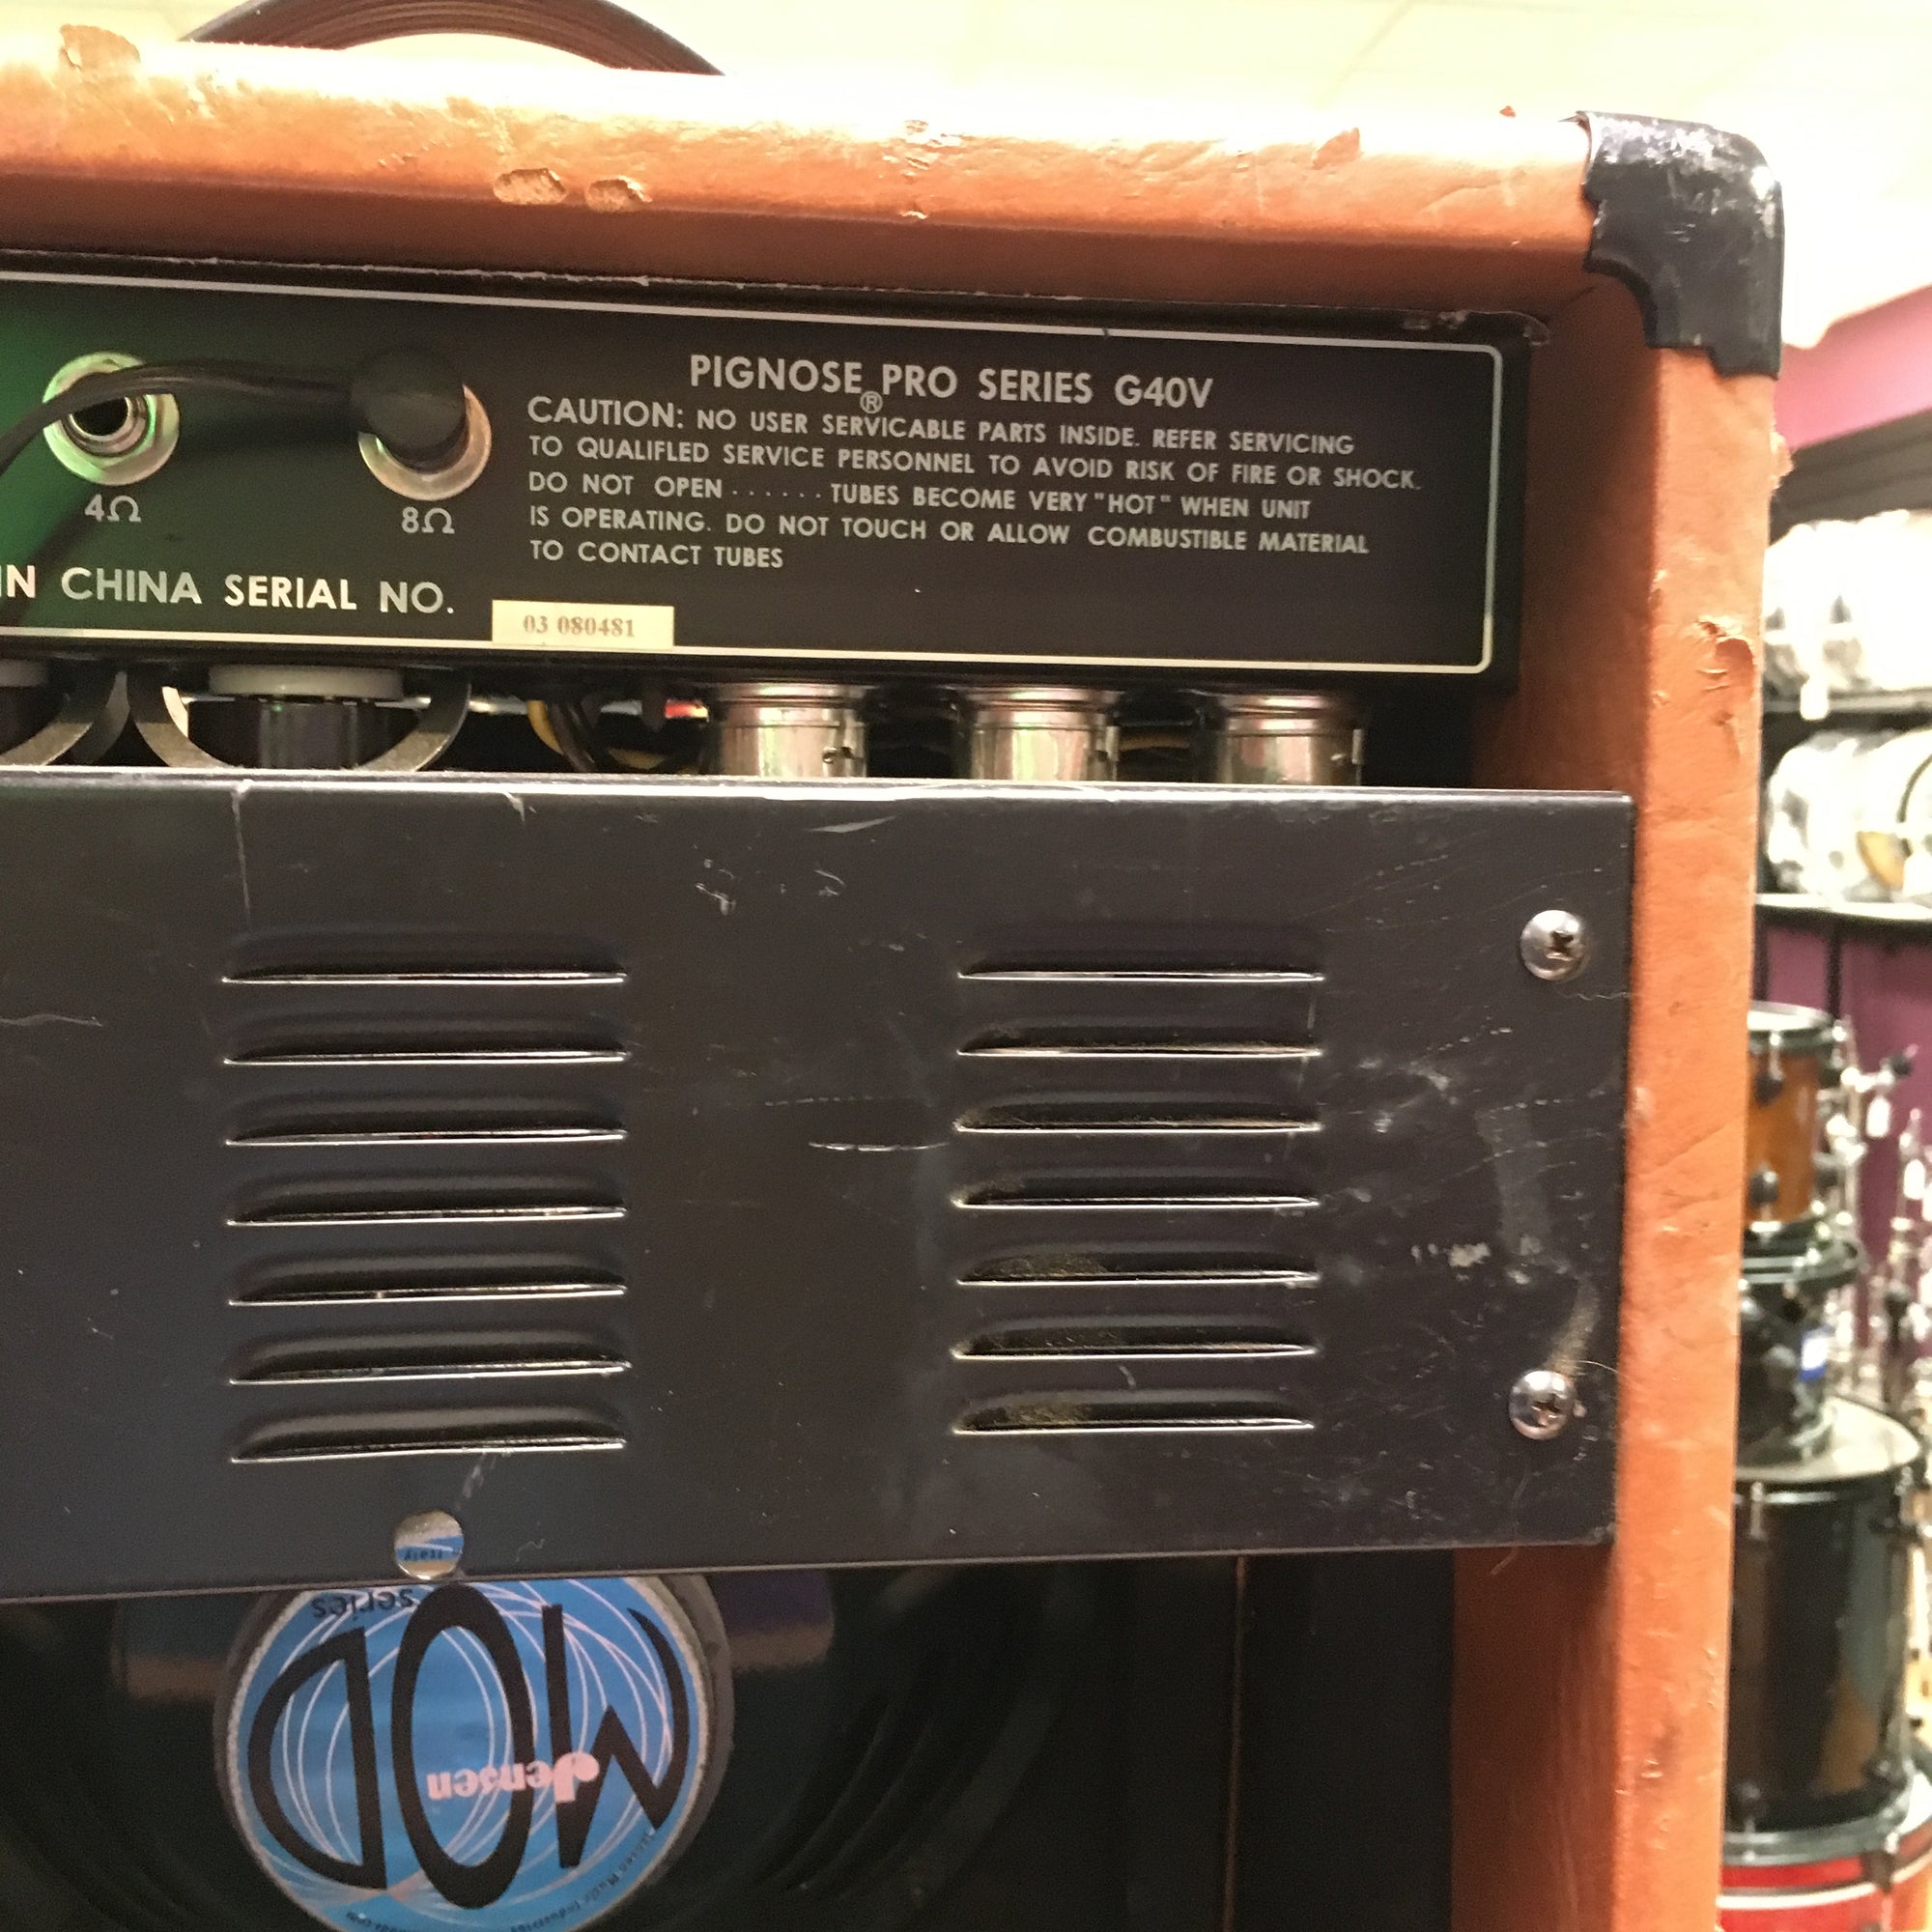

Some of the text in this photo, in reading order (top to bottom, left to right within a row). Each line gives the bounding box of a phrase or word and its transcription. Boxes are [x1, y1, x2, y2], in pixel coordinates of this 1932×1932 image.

[690, 355, 1213, 408] PIGNOSE PRO SERIES G40V
[528, 396, 1354, 455] CAUTION: NO USER SERVICABLE PARTS INSIDE. REFER SERVICING
[529, 435, 562, 458] TO
[723, 444, 825, 468] SERVICE
[838, 448, 975, 473] PERSONNEL
[989, 455, 1019, 476] TO
[1033, 457, 1113, 479] AVOID
[1126, 461, 1175, 481] RISK
[1187, 463, 1218, 482] OF
[1232, 464, 1276, 485] FIRE
[1287, 467, 1321, 486] OR
[1333, 468, 1422, 491] SHOCK.
[528, 471, 568, 493] DO
[583, 473, 634, 496] NOT
[654, 476, 723, 498] OPEN
[831, 483, 898, 505] TUBES
[913, 486, 1015, 510] BECOME
[1029, 491, 1087, 512] VERY
[1180, 497, 1249, 518] WHEN
[1262, 499, 1312, 520] UNIT
[530, 506, 1370, 554] IS OPERATING. DO NOT TOUCH OR ALLOW COMBUSTIBLE MATERIAL
[530, 540, 783, 569] TO CONTACT TUBES
[61, 566, 203, 606] CHINA
[224, 573, 356, 611] SERIAL
[380, 581, 454, 614] NO.
[523, 614, 635, 638] 03 080481
[309, 1588, 414, 1623] series
[247, 1583, 690, 1909] MOD
